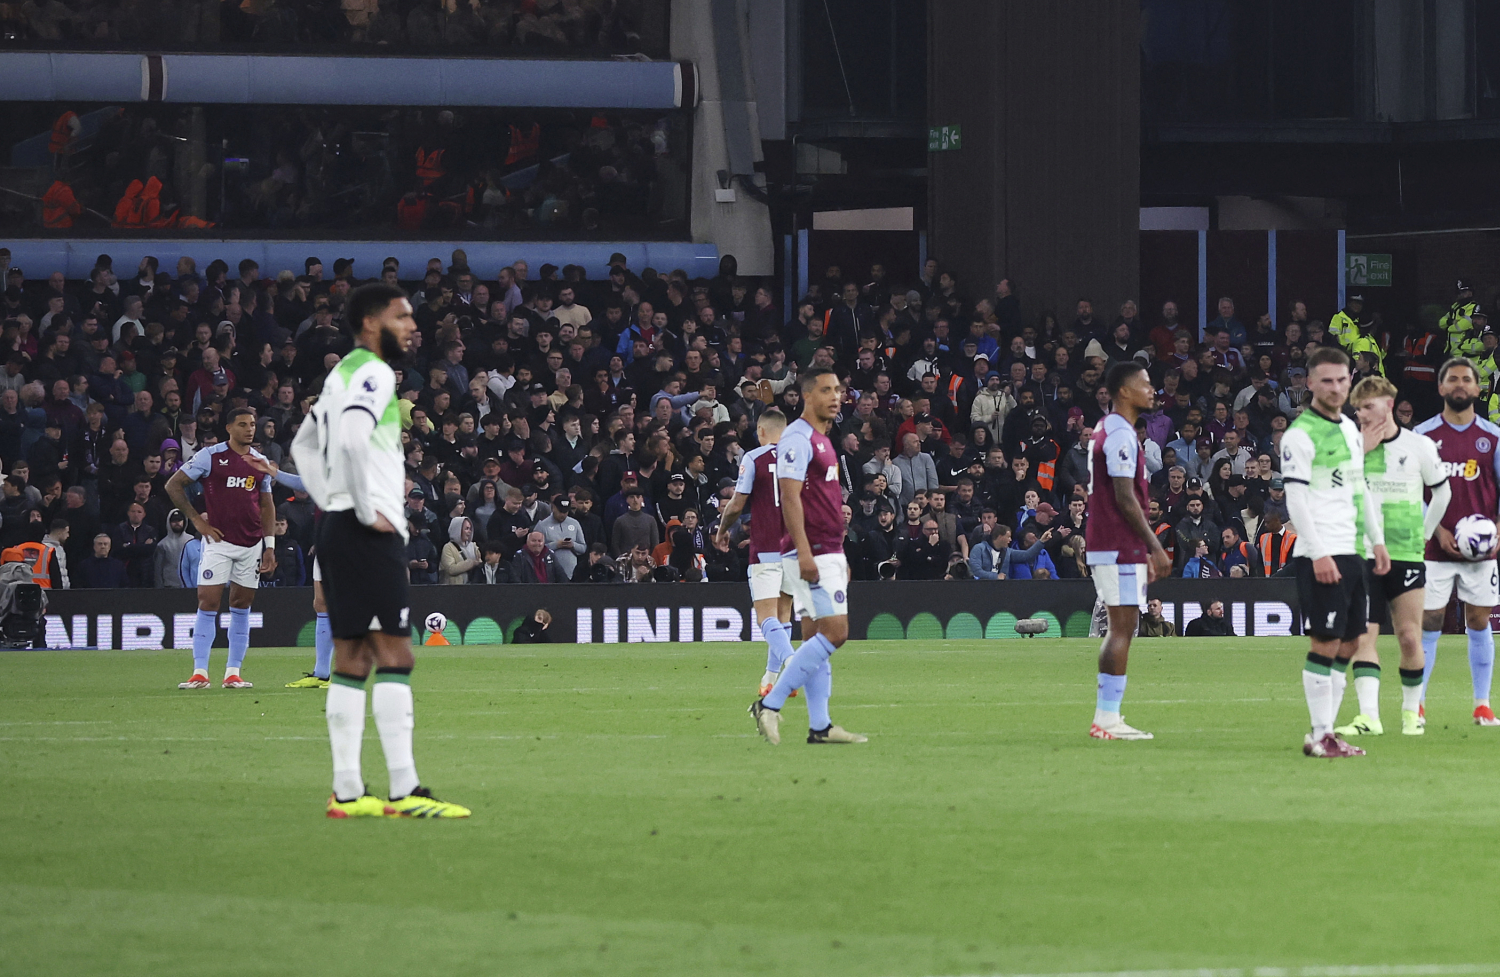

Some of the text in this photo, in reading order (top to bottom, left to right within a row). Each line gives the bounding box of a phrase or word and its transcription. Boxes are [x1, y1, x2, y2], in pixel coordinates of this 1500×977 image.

[1370, 260, 1390, 270] Fire
[1370, 271, 1389, 280] exit
[226, 475, 257, 491] BK8
[1490, 567, 1498, 587] 6
